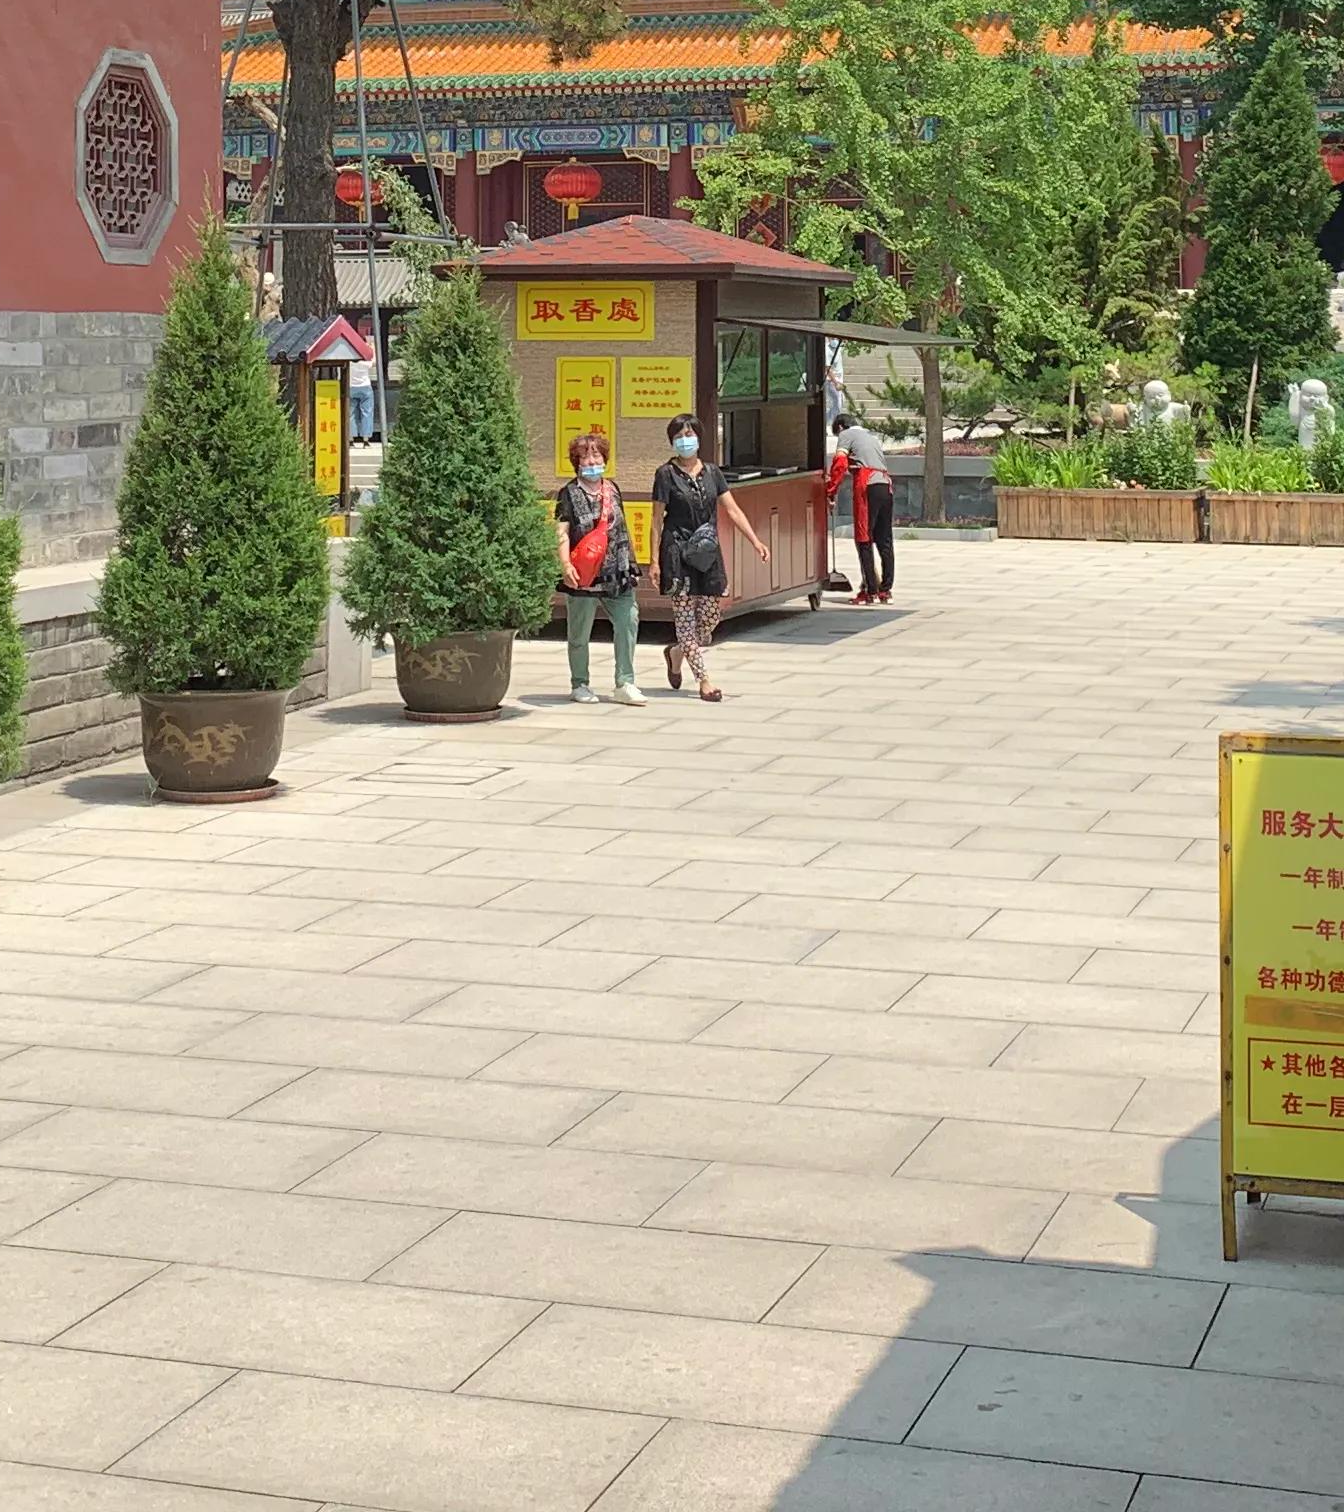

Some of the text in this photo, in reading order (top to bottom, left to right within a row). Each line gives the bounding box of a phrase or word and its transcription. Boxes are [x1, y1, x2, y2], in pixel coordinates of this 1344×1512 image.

[530, 298, 641, 323] 取香處
[589, 374, 607, 435] 自行取
